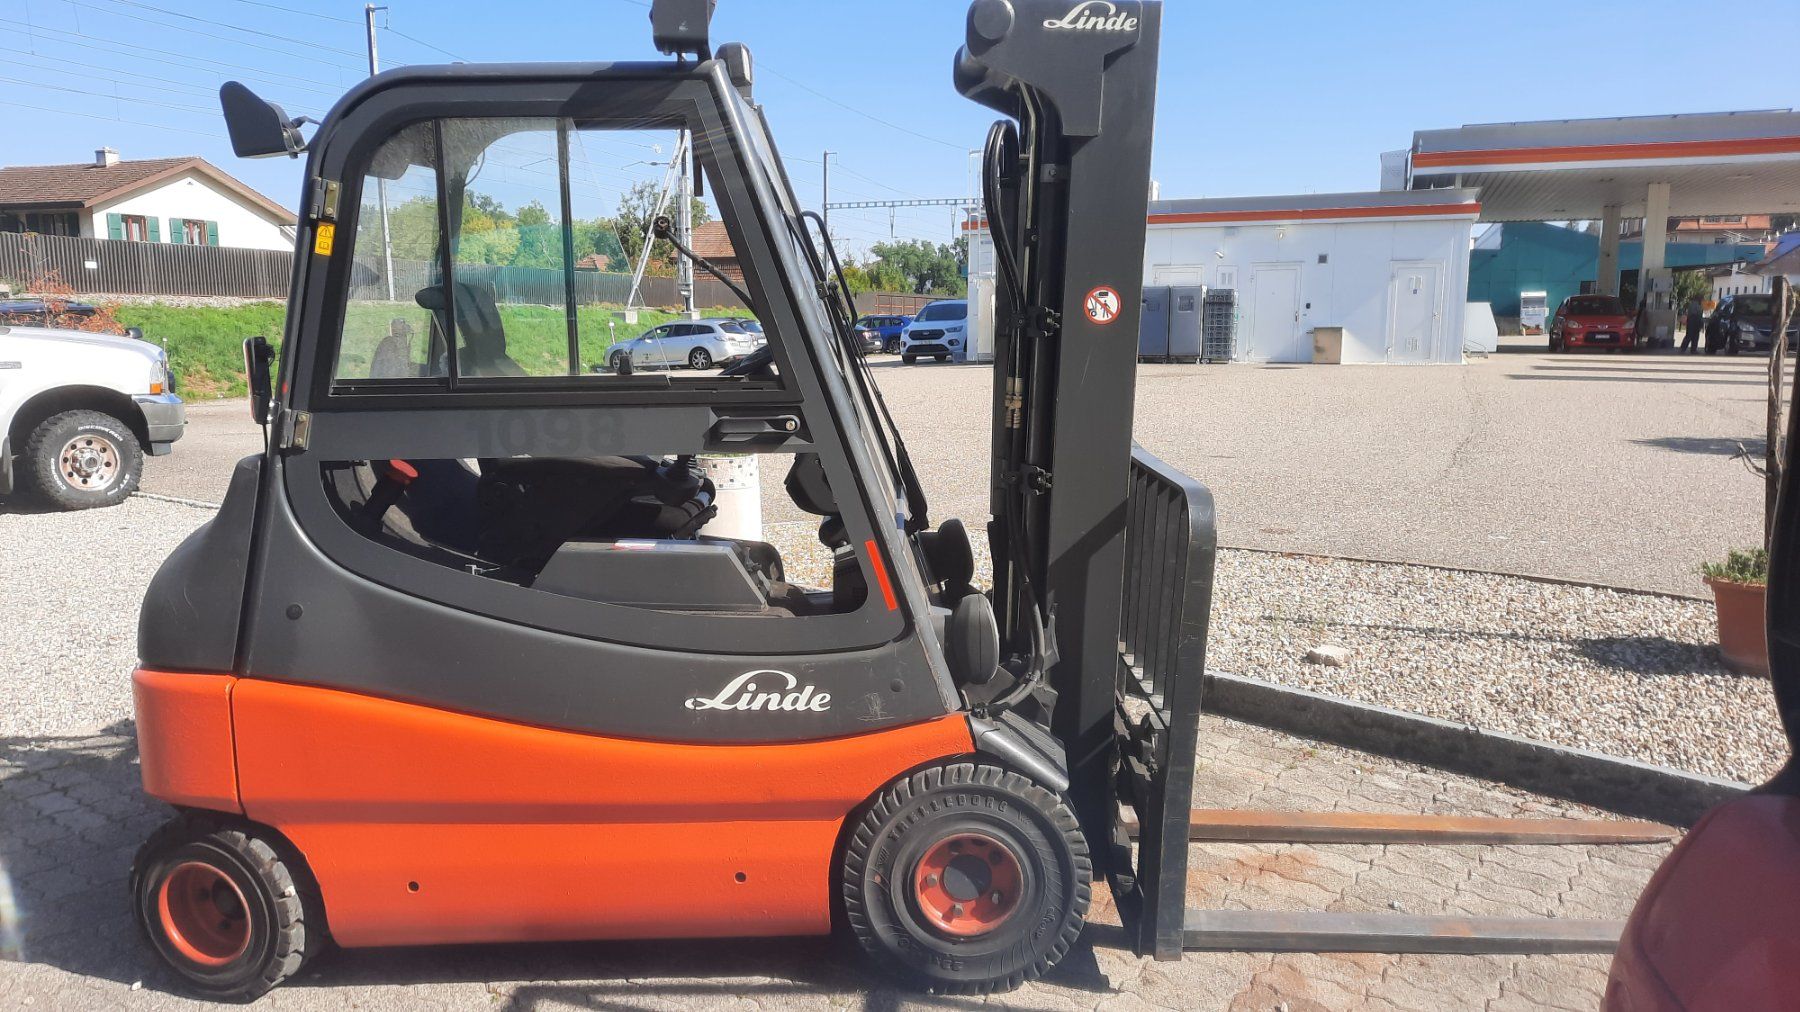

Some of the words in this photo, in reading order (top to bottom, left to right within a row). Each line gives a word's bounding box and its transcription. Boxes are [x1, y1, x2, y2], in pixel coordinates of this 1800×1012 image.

[1042, 1, 1138, 31] Linde
[464, 408, 627, 454] 1098
[684, 669, 832, 712] Linde
